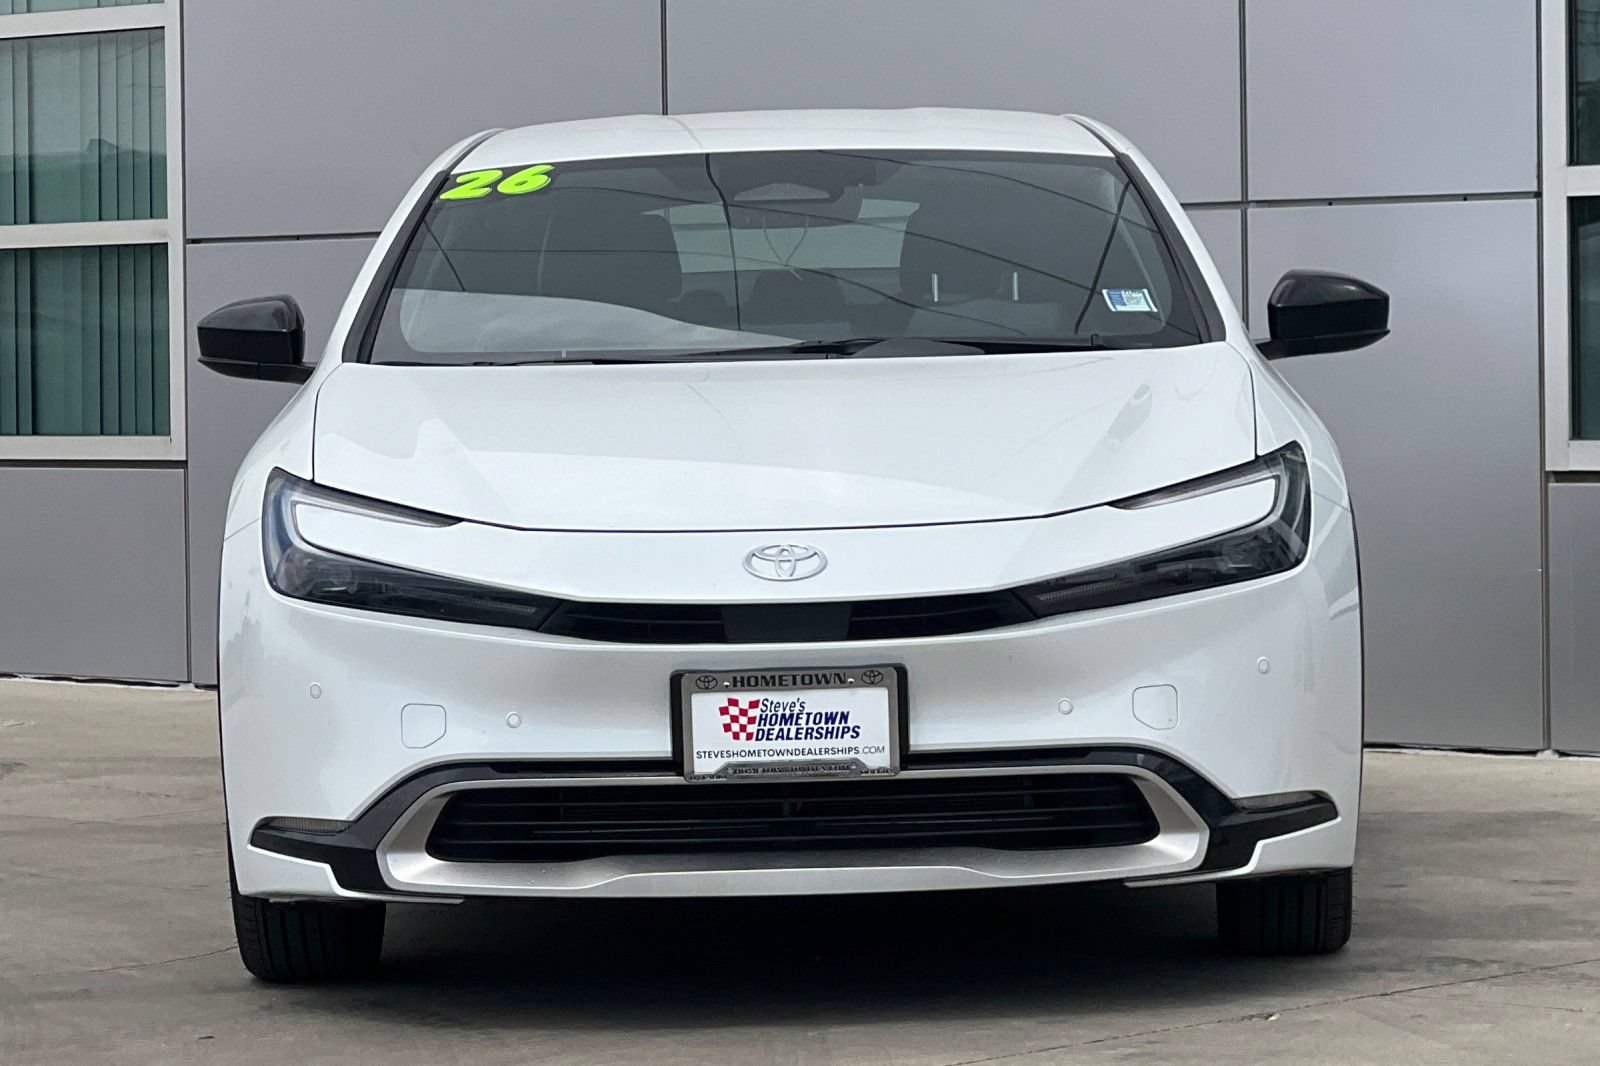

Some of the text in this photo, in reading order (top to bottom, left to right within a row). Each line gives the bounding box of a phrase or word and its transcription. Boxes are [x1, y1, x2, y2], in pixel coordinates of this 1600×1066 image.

[440, 164, 555, 199] 26
[732, 673, 847, 688] HOMETOWN
[760, 698, 806, 713] Steve's
[758, 711, 850, 726] HOMETOWN
[755, 725, 860, 741] DEALERSHIPS
[696, 746, 885, 760] STEVESHOMETOWNDEALERSHIPS.COM
